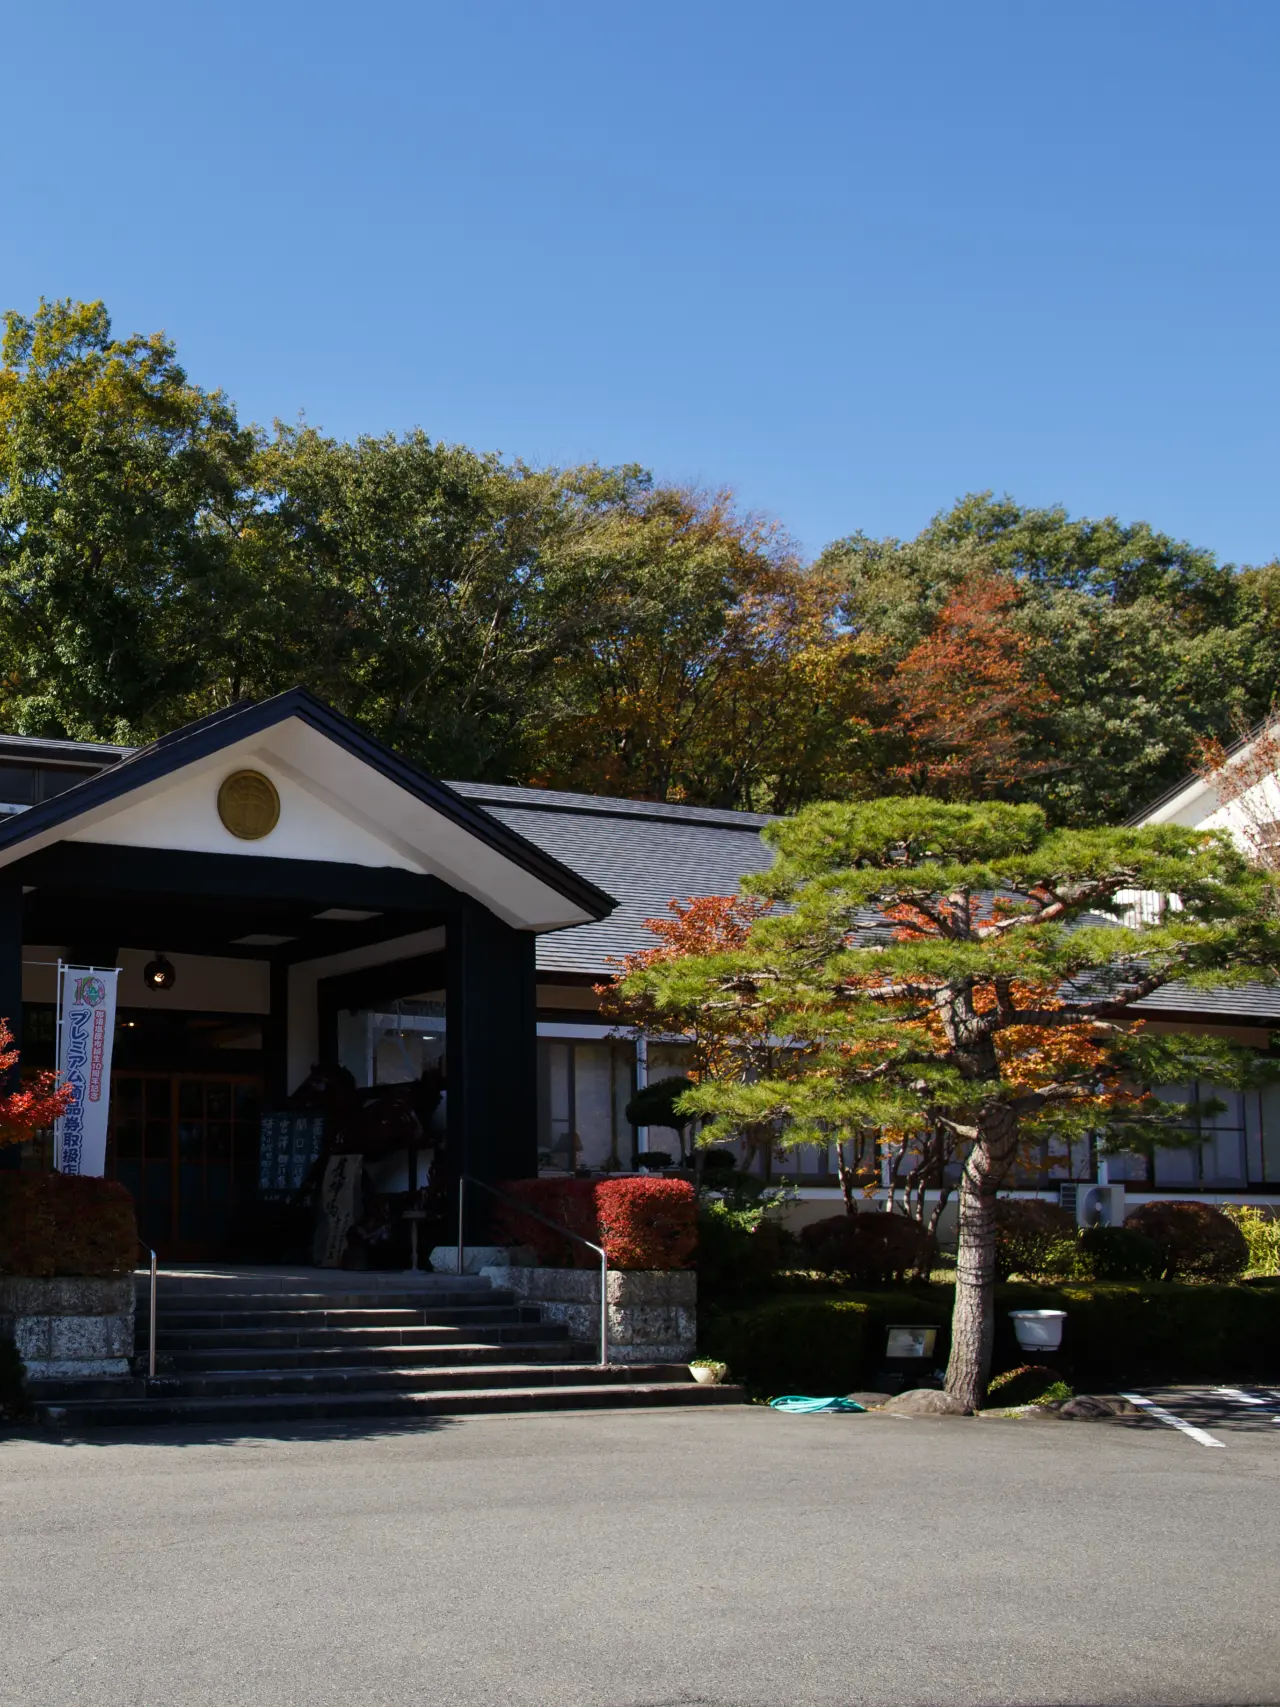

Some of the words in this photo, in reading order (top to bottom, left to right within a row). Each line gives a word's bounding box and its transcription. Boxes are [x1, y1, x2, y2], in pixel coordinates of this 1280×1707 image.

[72, 977, 105, 1006] 10
[63, 1009, 91, 1175] プレミアム商品券取扱店
